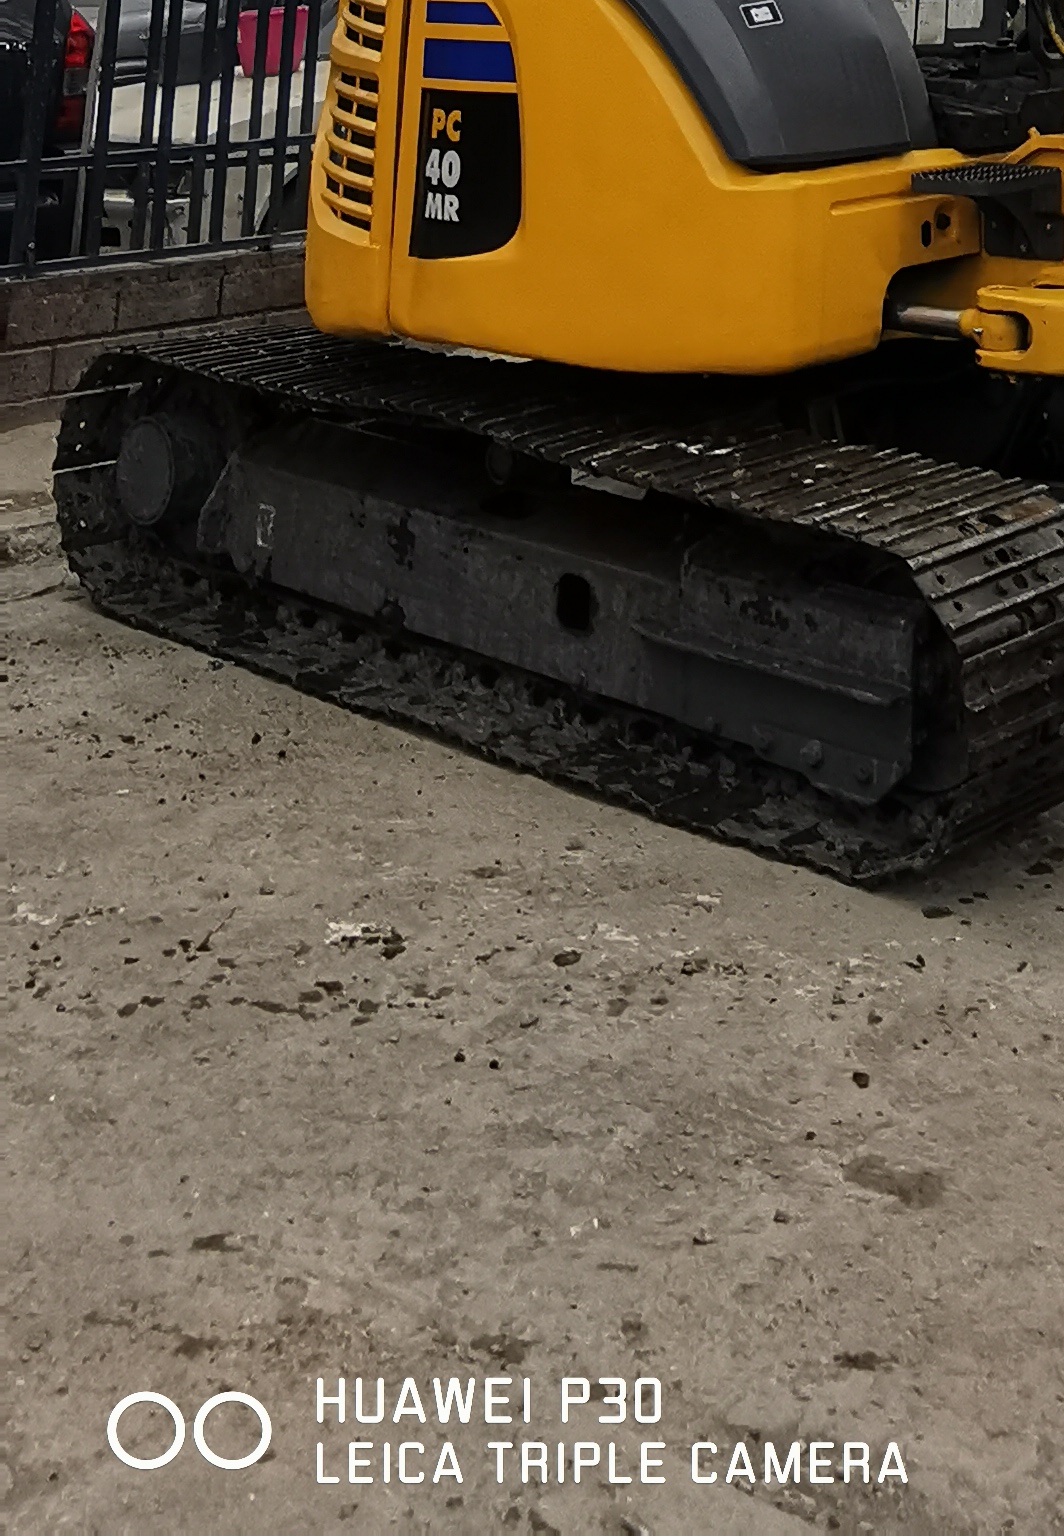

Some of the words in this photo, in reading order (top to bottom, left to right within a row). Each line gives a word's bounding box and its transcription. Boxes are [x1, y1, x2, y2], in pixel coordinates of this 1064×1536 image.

[431, 108, 462, 142] PC
[425, 148, 461, 188] 40
[424, 191, 460, 222] MR
